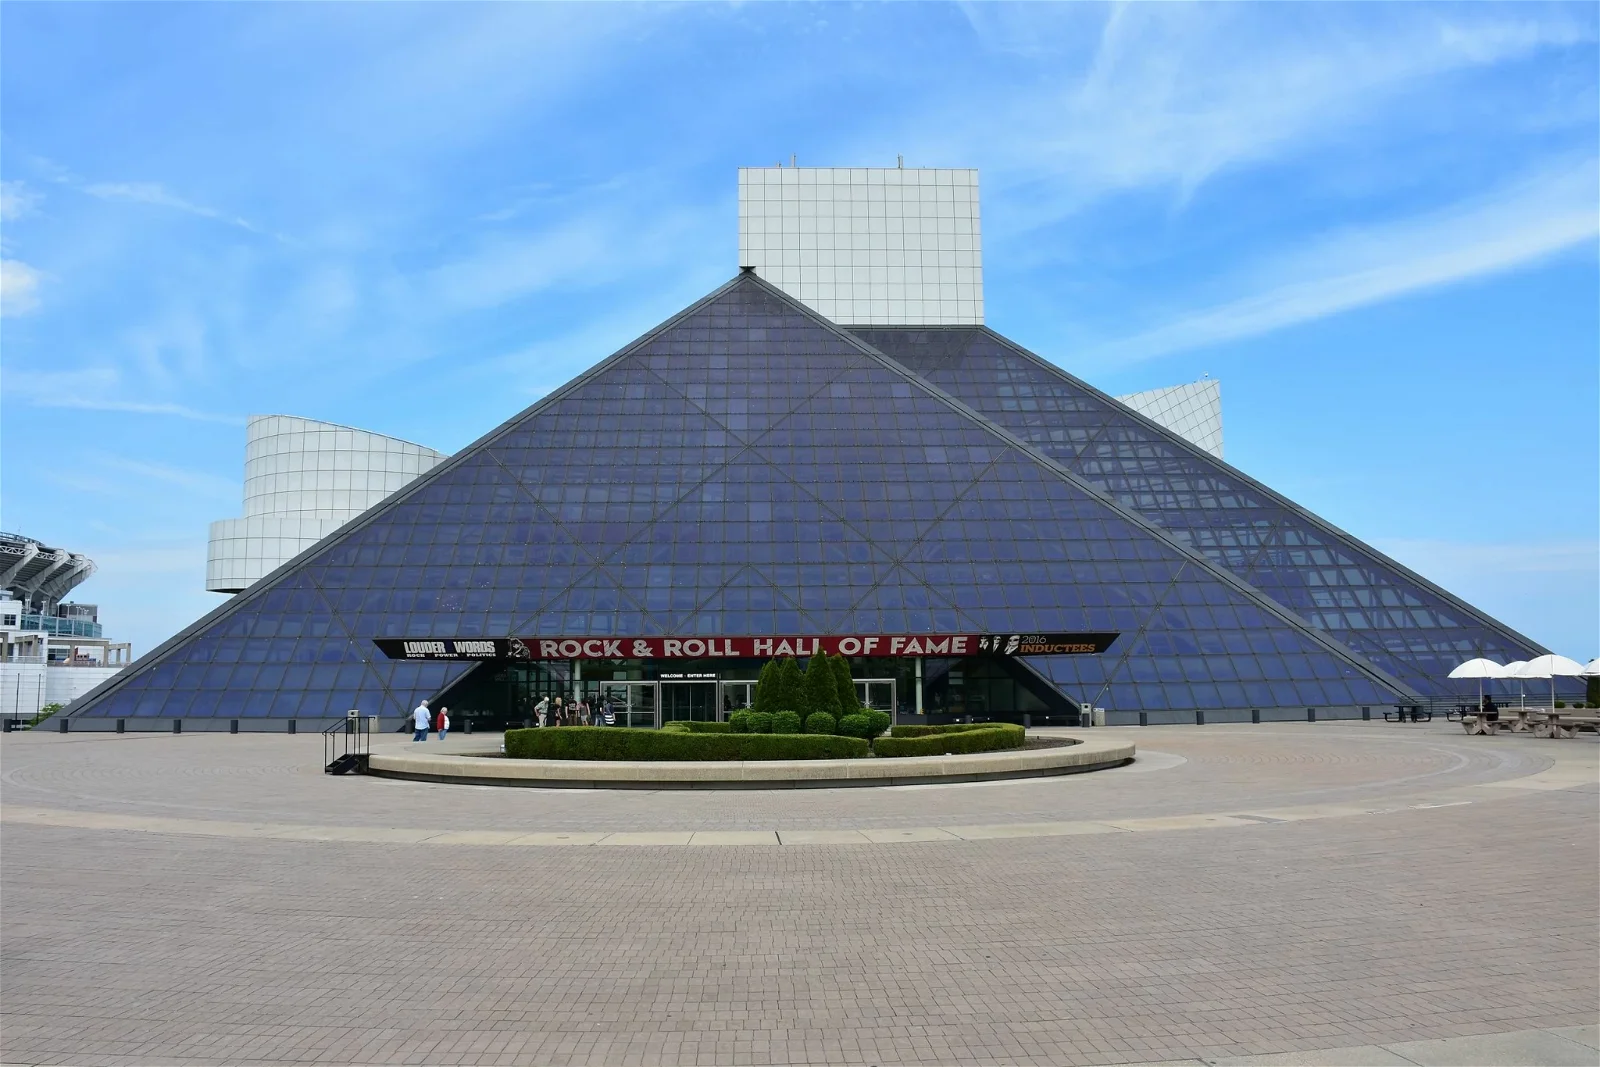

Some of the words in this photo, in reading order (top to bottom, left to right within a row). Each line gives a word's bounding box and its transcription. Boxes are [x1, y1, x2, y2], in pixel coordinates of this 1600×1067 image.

[1021, 636, 1047, 644] 2016
[404, 642, 446, 653] LOUDER
[453, 641, 496, 653] WORDS
[540, 640, 624, 657] ROCK
[632, 640, 653, 656] &
[663, 639, 740, 657] ROLL
[753, 638, 827, 656] HALL
[839, 638, 879, 655] OF
[891, 637, 968, 654] FAME
[1020, 644, 1095, 653] INDUCTEES
